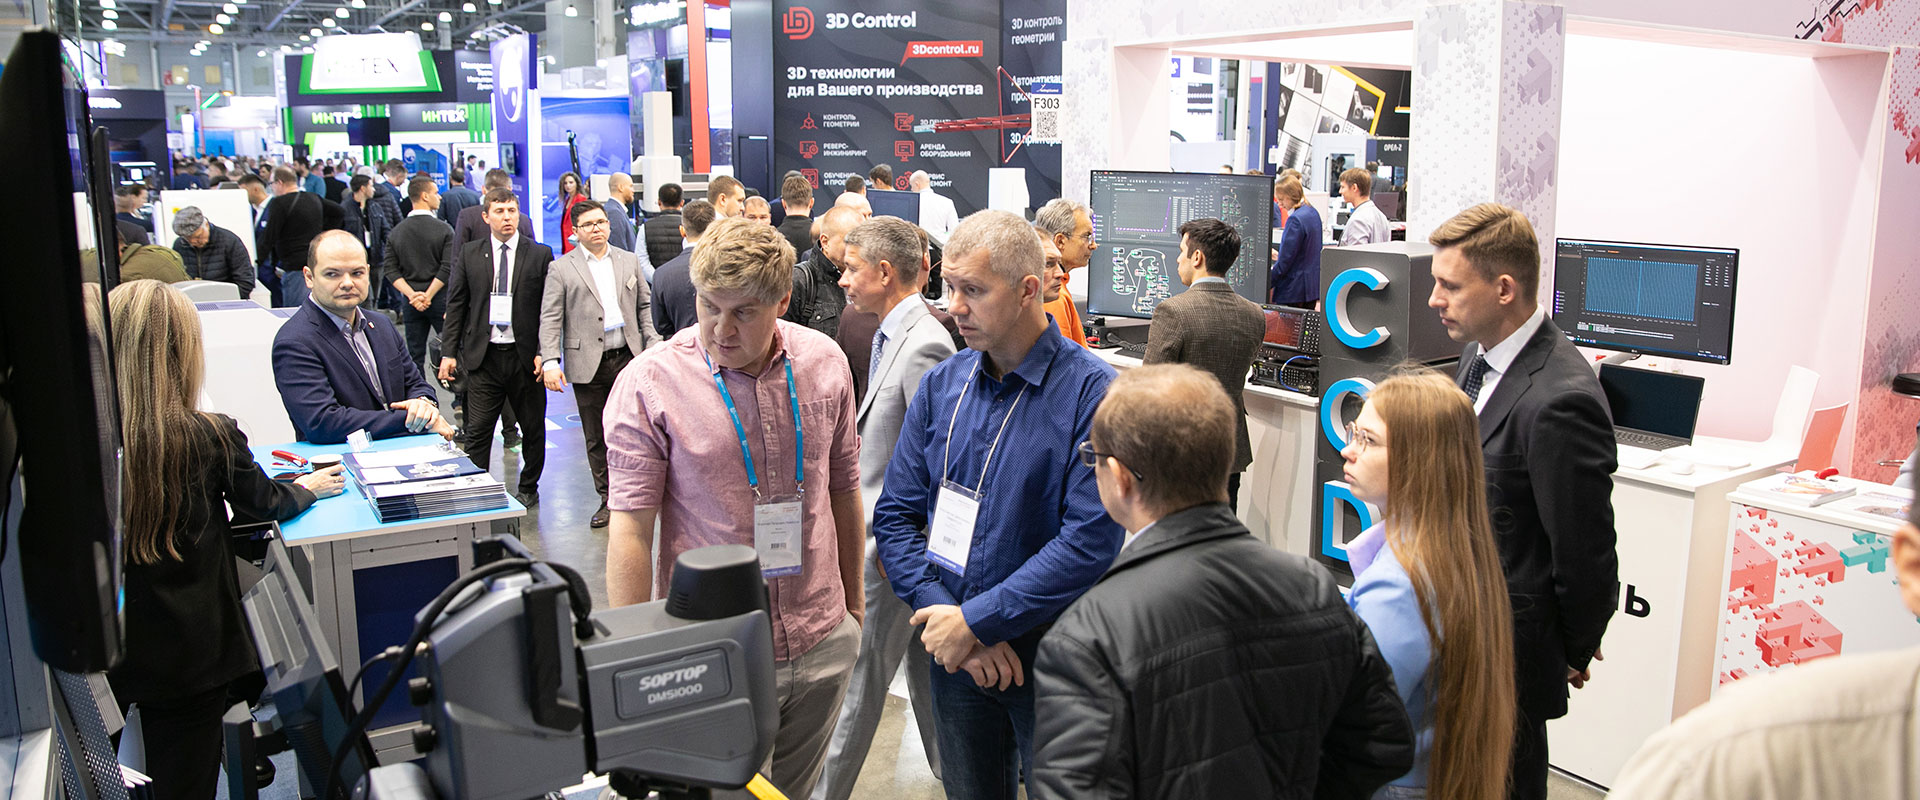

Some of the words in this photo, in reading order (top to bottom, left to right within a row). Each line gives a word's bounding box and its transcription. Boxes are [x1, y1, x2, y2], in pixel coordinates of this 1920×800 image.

[826, 13, 849, 29] 3D
[852, 11, 916, 28] Control
[1011, 18, 1023, 30] 3D
[1024, 15, 1063, 29] контроль
[1011, 32, 1055, 45] геометрии
[912, 44, 979, 55] 3Dcontrol.ru
[787, 68, 807, 80] 3D
[810, 67, 895, 79] технологии
[787, 86, 814, 99] для
[817, 84, 874, 96] Вашего
[876, 84, 984, 99] производства
[1034, 97, 1060, 109] F303
[421, 110, 465, 124] ИНТЕХ
[1010, 132, 1021, 144] 3D
[920, 150, 972, 158] ОБОРУДОВАНИЯ
[639, 664, 708, 691] SOPTOP
[647, 683, 703, 704] DMS1000
